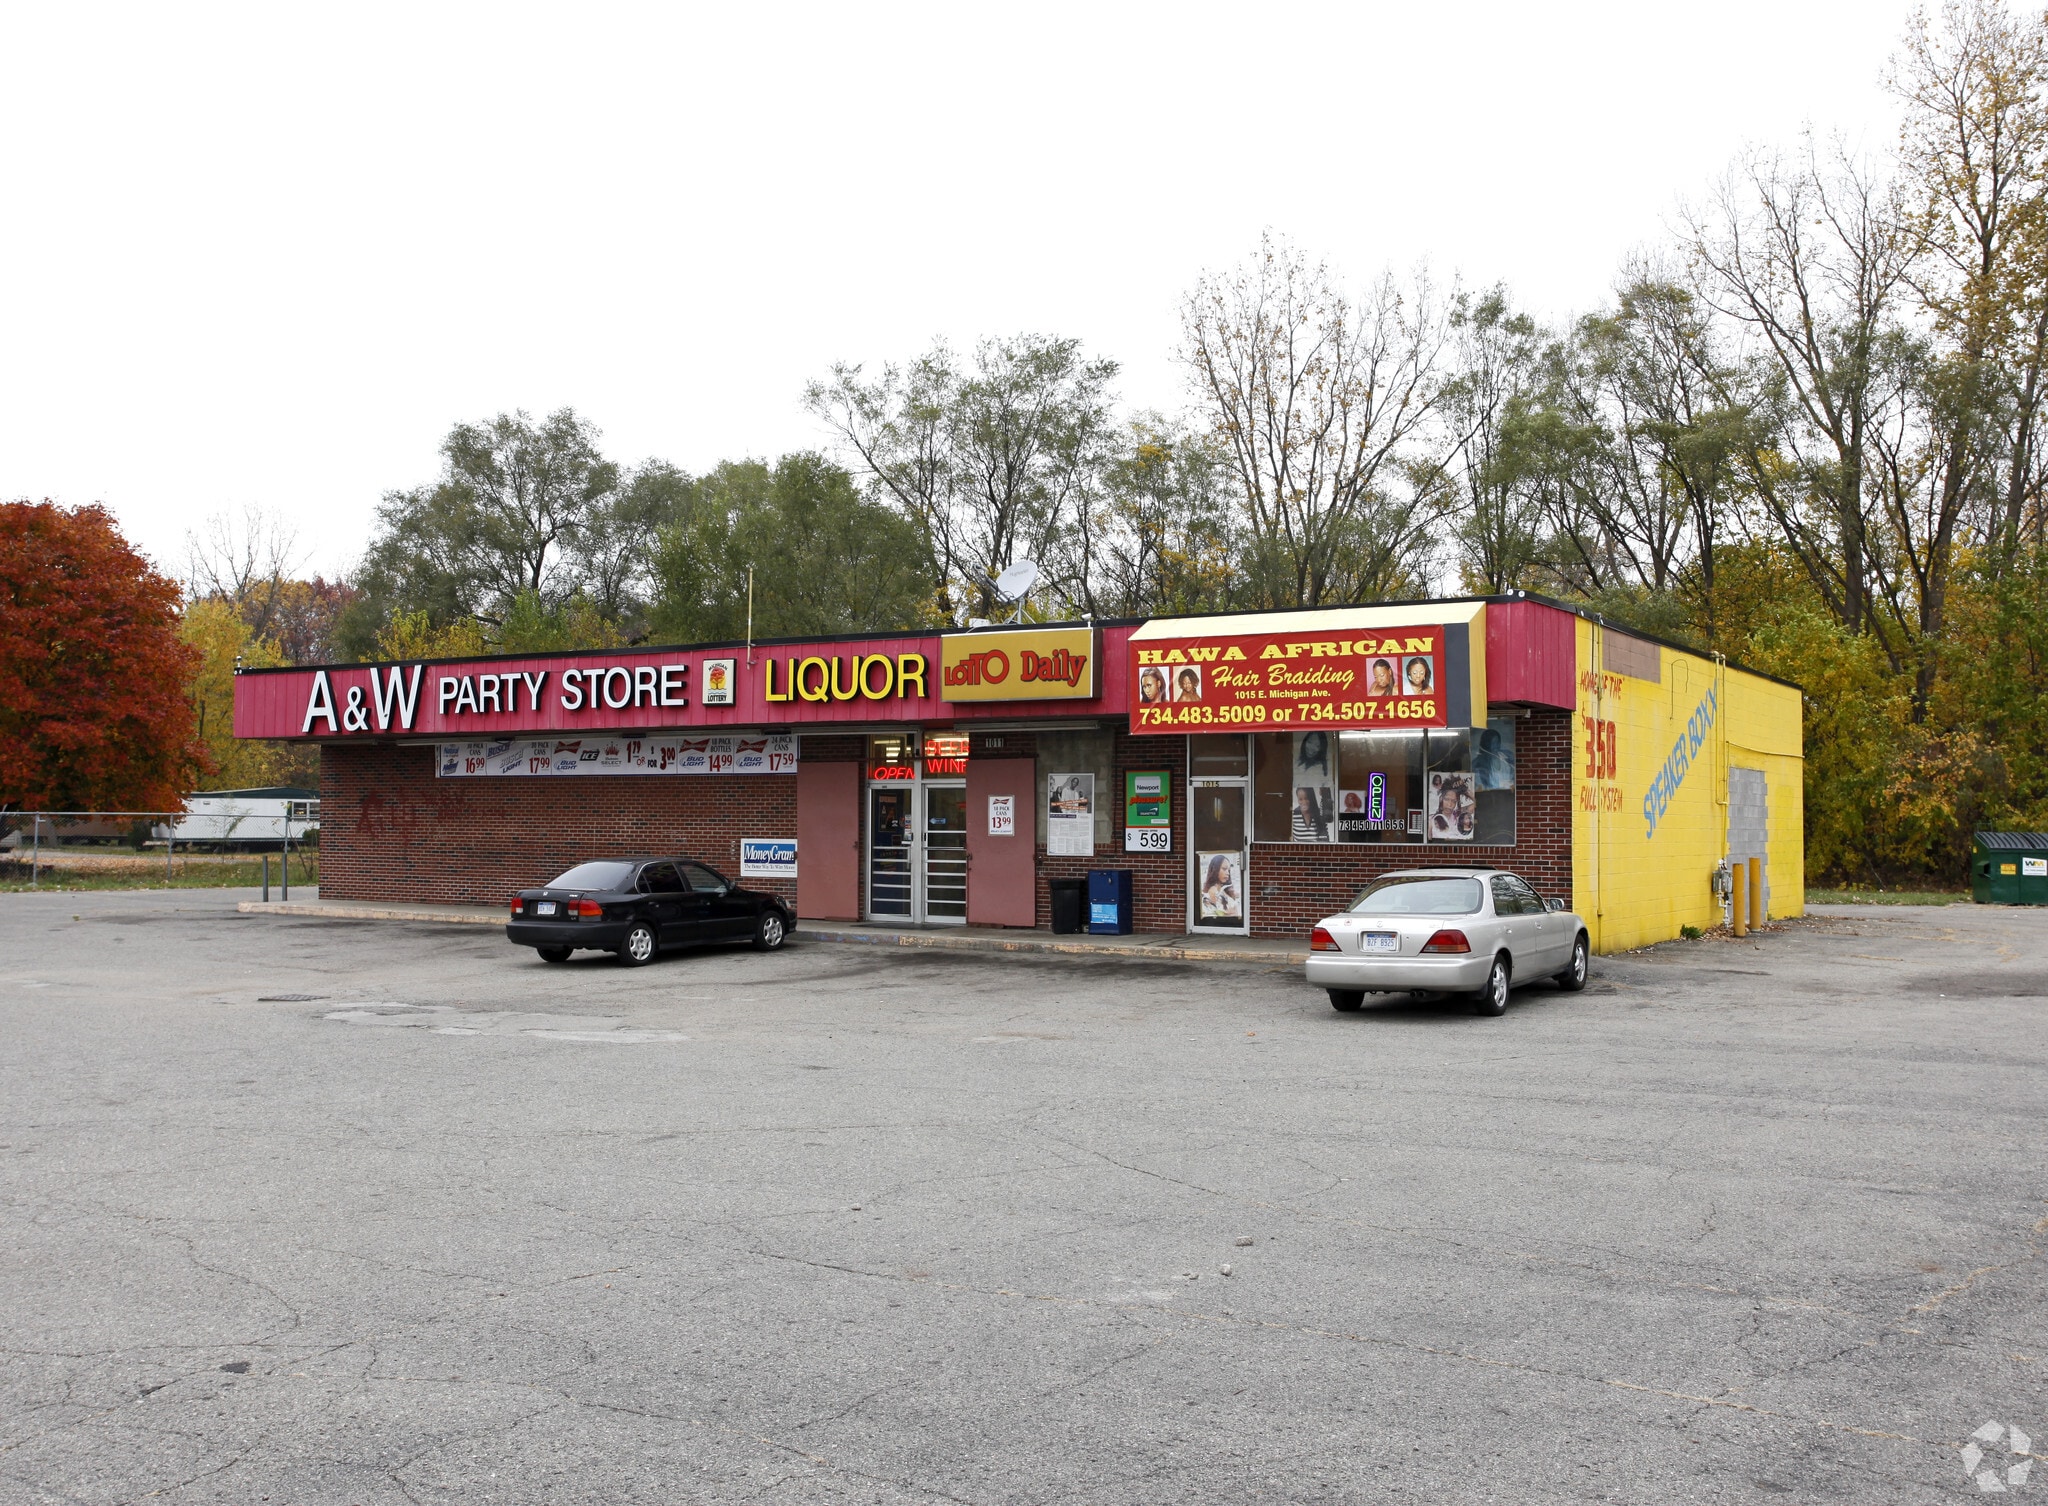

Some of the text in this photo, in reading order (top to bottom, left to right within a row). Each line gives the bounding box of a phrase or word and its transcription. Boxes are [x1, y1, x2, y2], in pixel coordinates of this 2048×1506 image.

[1137, 637, 1434, 665] HAWA AFRICAN
[708, 663, 728, 671] MICHIGAN
[944, 649, 1087, 687] LOTTO Daily
[765, 653, 928, 703] LIQUOR
[1211, 664, 1355, 690] Hair Braiding
[1580, 670, 1598, 695] HOME
[1609, 676, 1622, 700] THE
[439, 671, 548, 714] PARTY
[561, 664, 688, 711] STORE
[1234, 688, 1331, 700] 1015 E. Michigan Ave.
[1139, 700, 1436, 725] 734.483.5009 or 734.507.1656
[774, 744, 789, 752] CANS
[778, 736, 793, 744] PACK
[926, 740, 969, 756] BEER
[488, 741, 511, 758] BUSCH
[582, 752, 598, 760] ICE
[710, 745, 732, 753] BOTTLES
[1585, 717, 1617, 780] 350
[503, 760, 523, 774] LIGHT
[647, 759, 657, 768] FOR
[874, 766, 915, 780] OPEN
[1643, 732, 1689, 840] SPEAKER
[1371, 775, 1383, 819] OPEN
[1127, 832, 1132, 841] $
